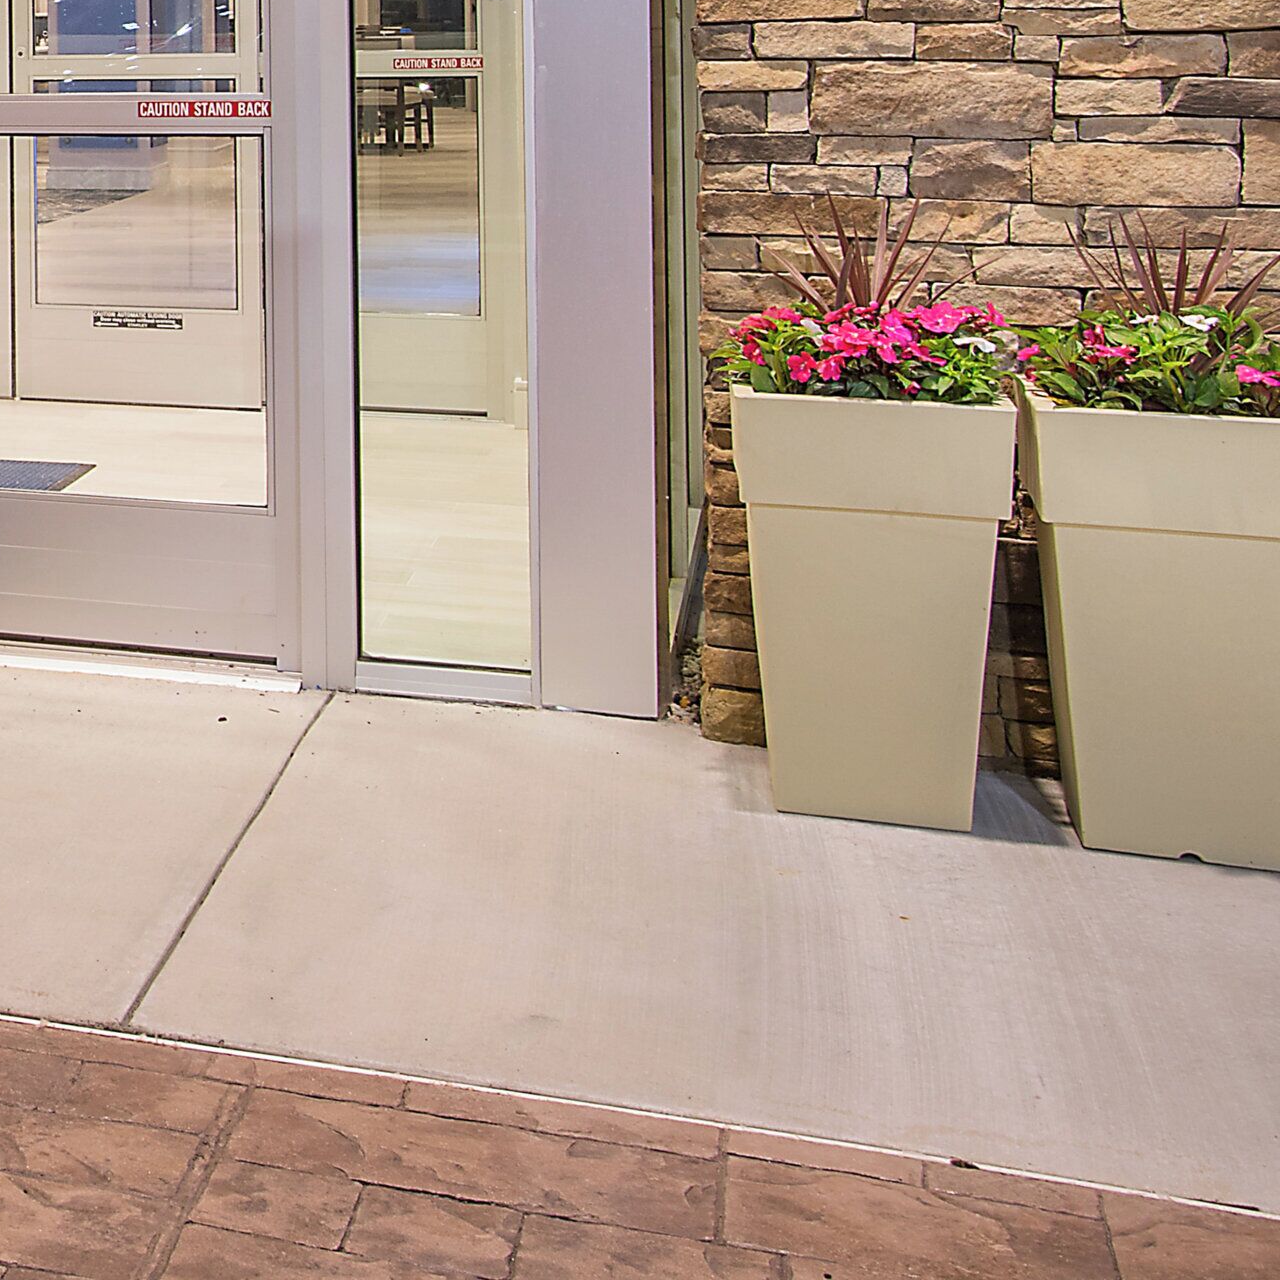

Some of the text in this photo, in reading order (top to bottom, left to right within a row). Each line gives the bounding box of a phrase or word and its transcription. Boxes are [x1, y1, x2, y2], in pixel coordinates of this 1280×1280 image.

[394, 58, 482, 69] CAUTION STAND BACK
[139, 102, 269, 117] CAUTION STAND BACK
